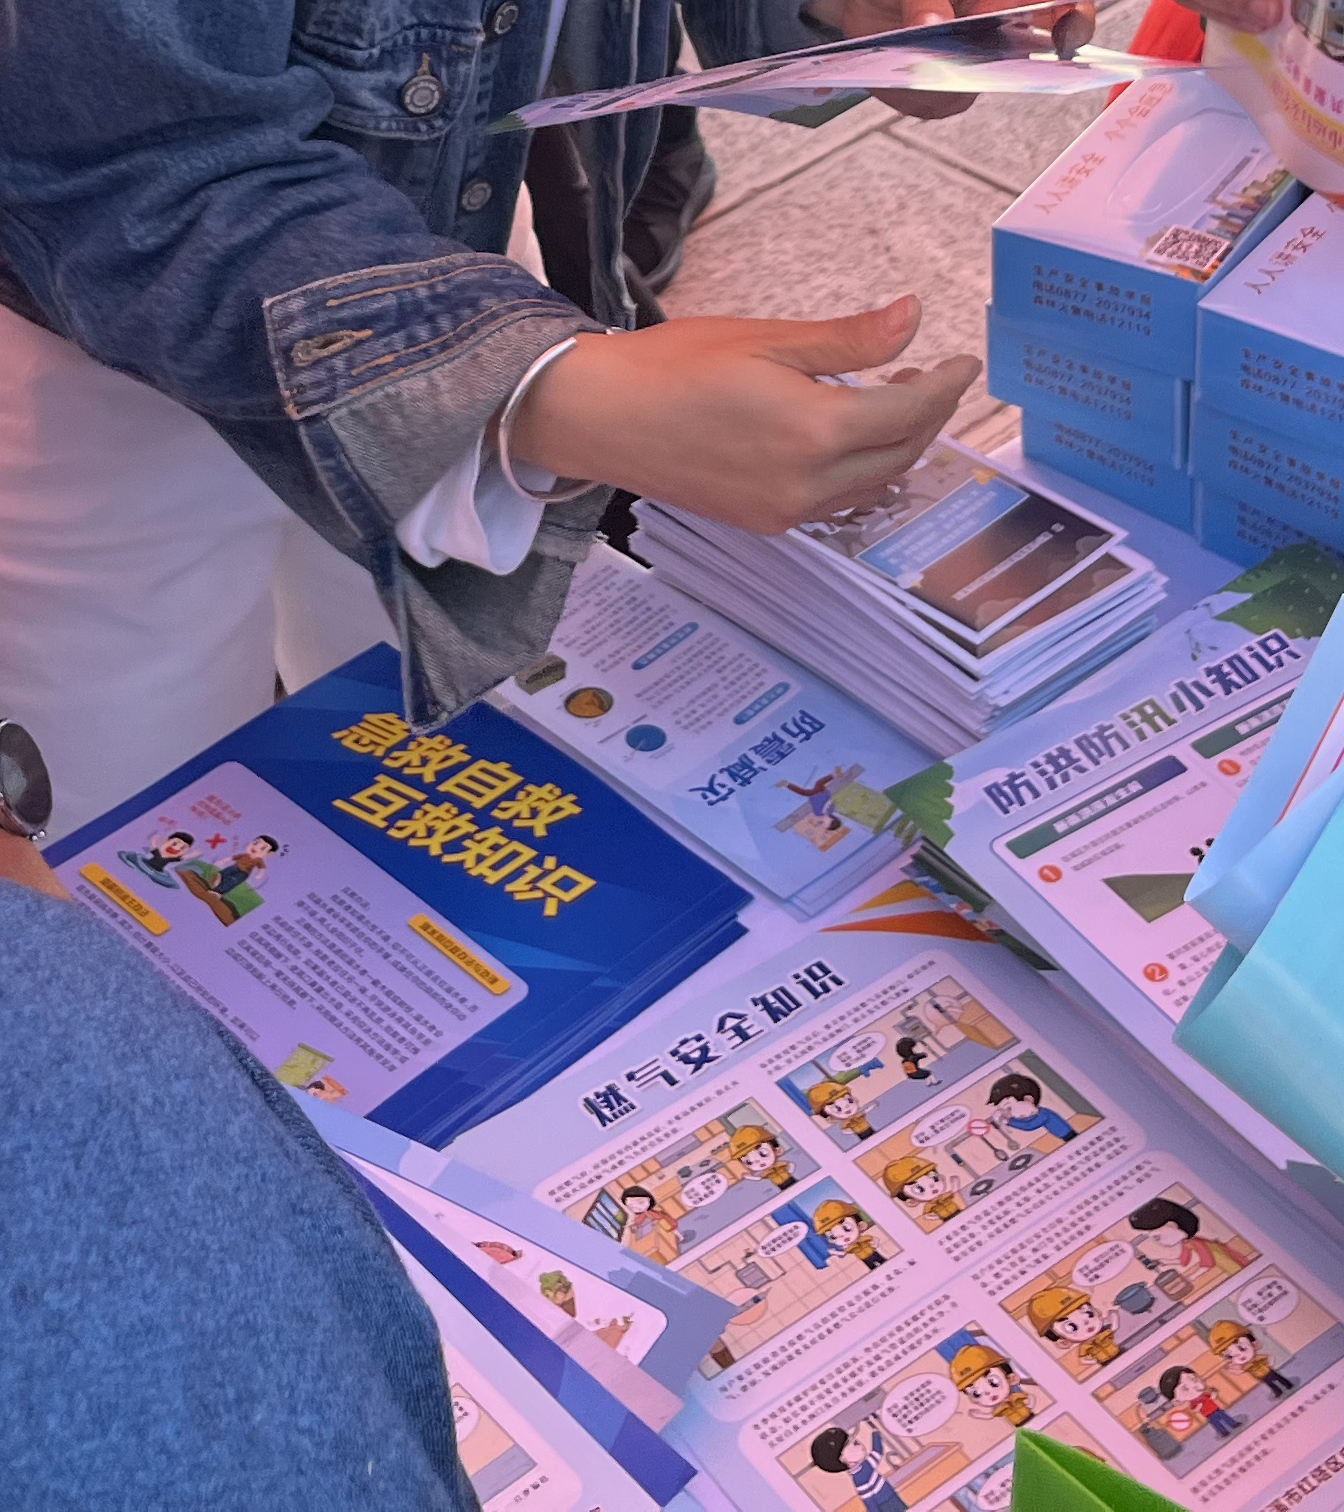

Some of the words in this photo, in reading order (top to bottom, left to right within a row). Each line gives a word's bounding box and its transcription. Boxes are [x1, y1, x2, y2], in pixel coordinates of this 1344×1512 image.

[1034, 150, 1107, 215] 人人讲安全
[1243, 224, 1327, 297] 人人讲安全
[332, 711, 582, 837] 急救自救
[687, 708, 826, 808] 防震减灾
[983, 632, 1303, 815] 防洪防汛小知识
[332, 774, 597, 917] 互救知识
[582, 960, 845, 1127] 燃气安全知识
